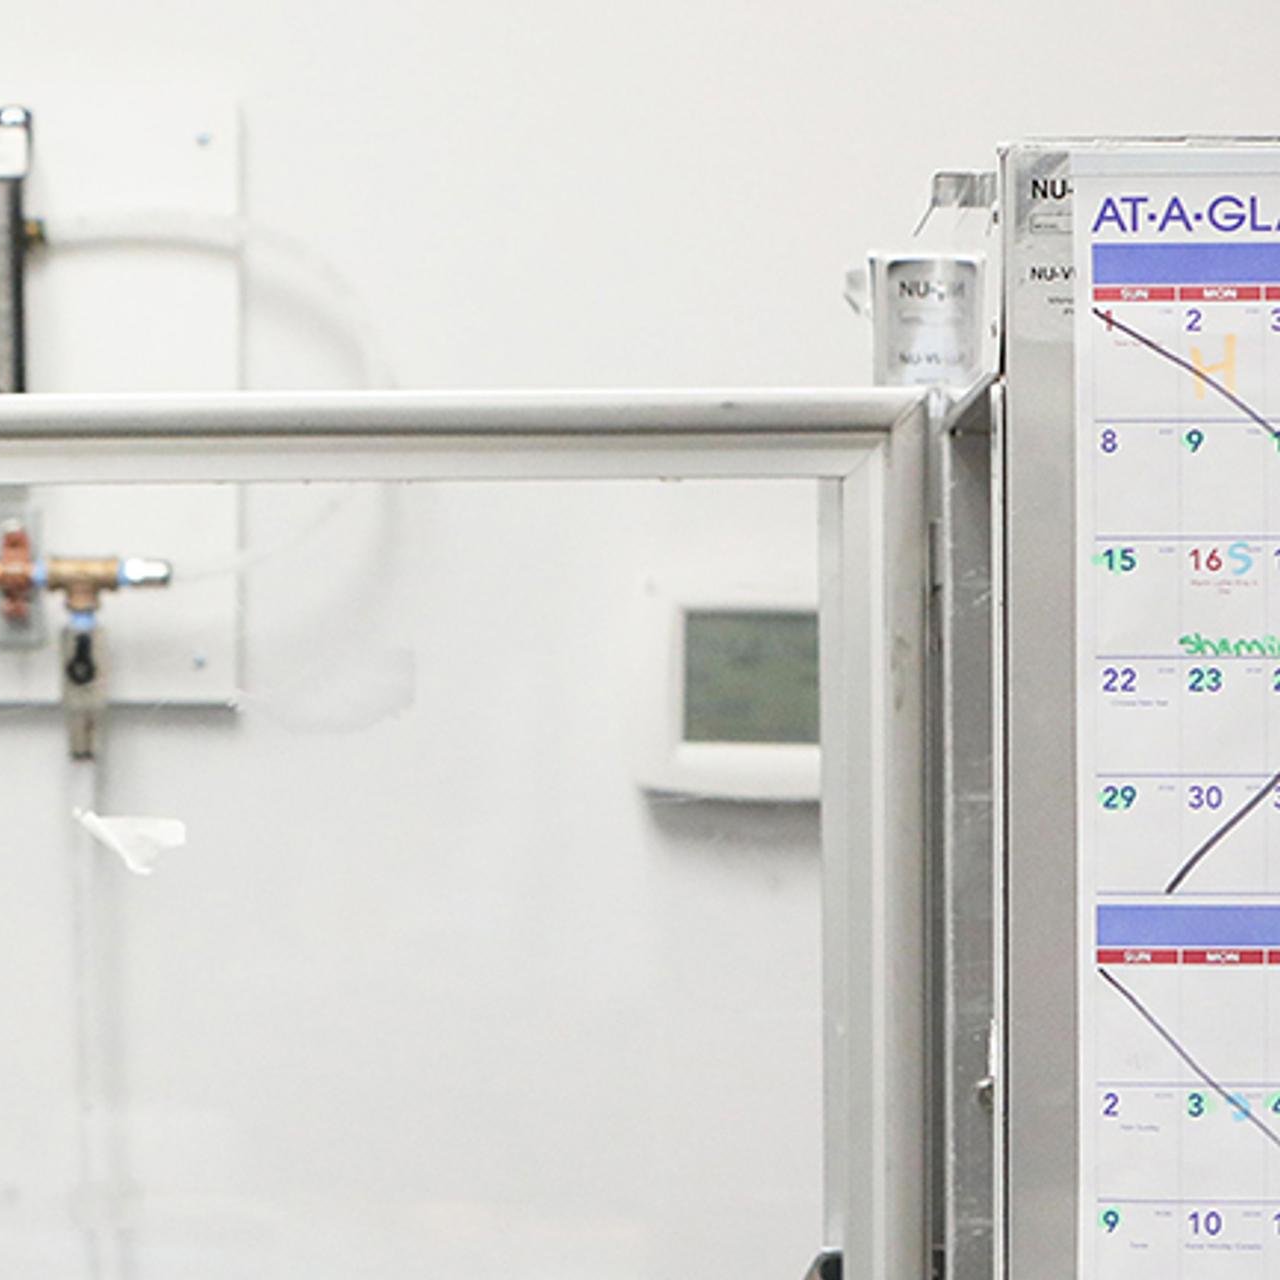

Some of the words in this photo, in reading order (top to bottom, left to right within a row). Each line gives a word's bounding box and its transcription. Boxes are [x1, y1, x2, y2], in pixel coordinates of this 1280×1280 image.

[1031, 178, 1074, 200] NU-
[1092, 195, 1280, 233] AT·A·GL
[1030, 266, 1075, 282] NU-V
[1186, 308, 1202, 332] 2
[1100, 429, 1118, 454] 8
[1186, 430, 1204, 453] 9
[1103, 548, 1137, 572] 15
[1189, 548, 1223, 572] 16
[1102, 667, 1137, 693] 22
[1188, 667, 1223, 693] 23
[1102, 785, 1137, 810] 29
[1188, 785, 1223, 810] 30
[1102, 1092, 1119, 1117] 2
[1188, 1092, 1205, 1118] 3
[1102, 1210, 1119, 1233] 9
[1188, 1210, 1223, 1236] 10
